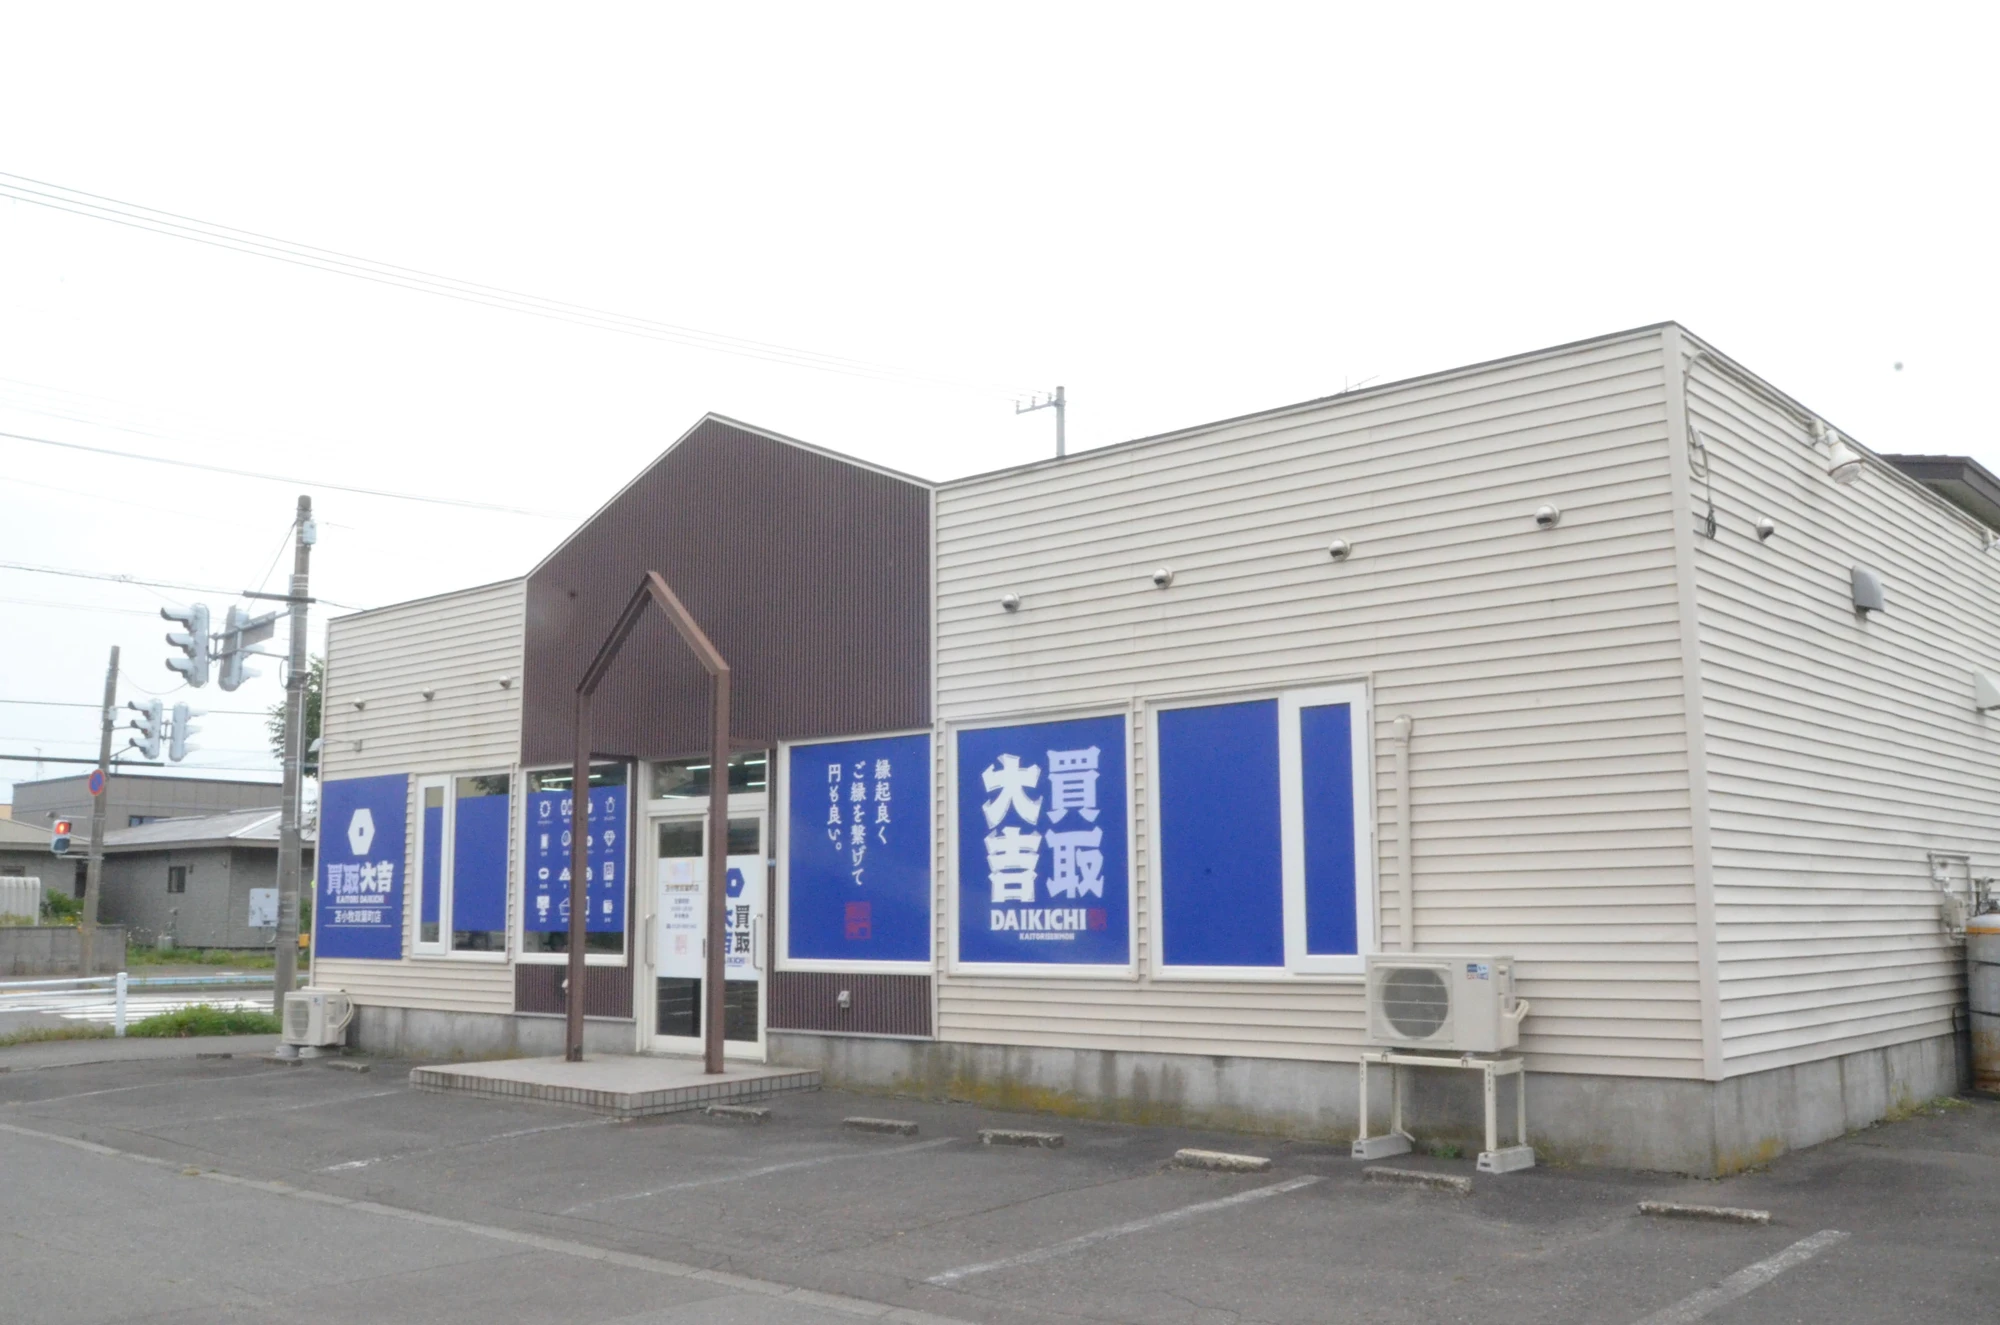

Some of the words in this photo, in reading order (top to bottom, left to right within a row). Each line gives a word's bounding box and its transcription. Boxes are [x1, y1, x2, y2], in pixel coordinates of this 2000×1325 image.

[827, 763, 843, 850] 円も良い。
[850, 760, 868, 886] ご縁を繋げて
[874, 758, 892, 845] 縁起良く
[981, 752, 1043, 903] 大吉
[1045, 745, 1104, 899] 買取
[327, 860, 395, 896] 買取大吉
[990, 908, 1087, 931] DAIKICHI
[735, 904, 750, 954] 買取
